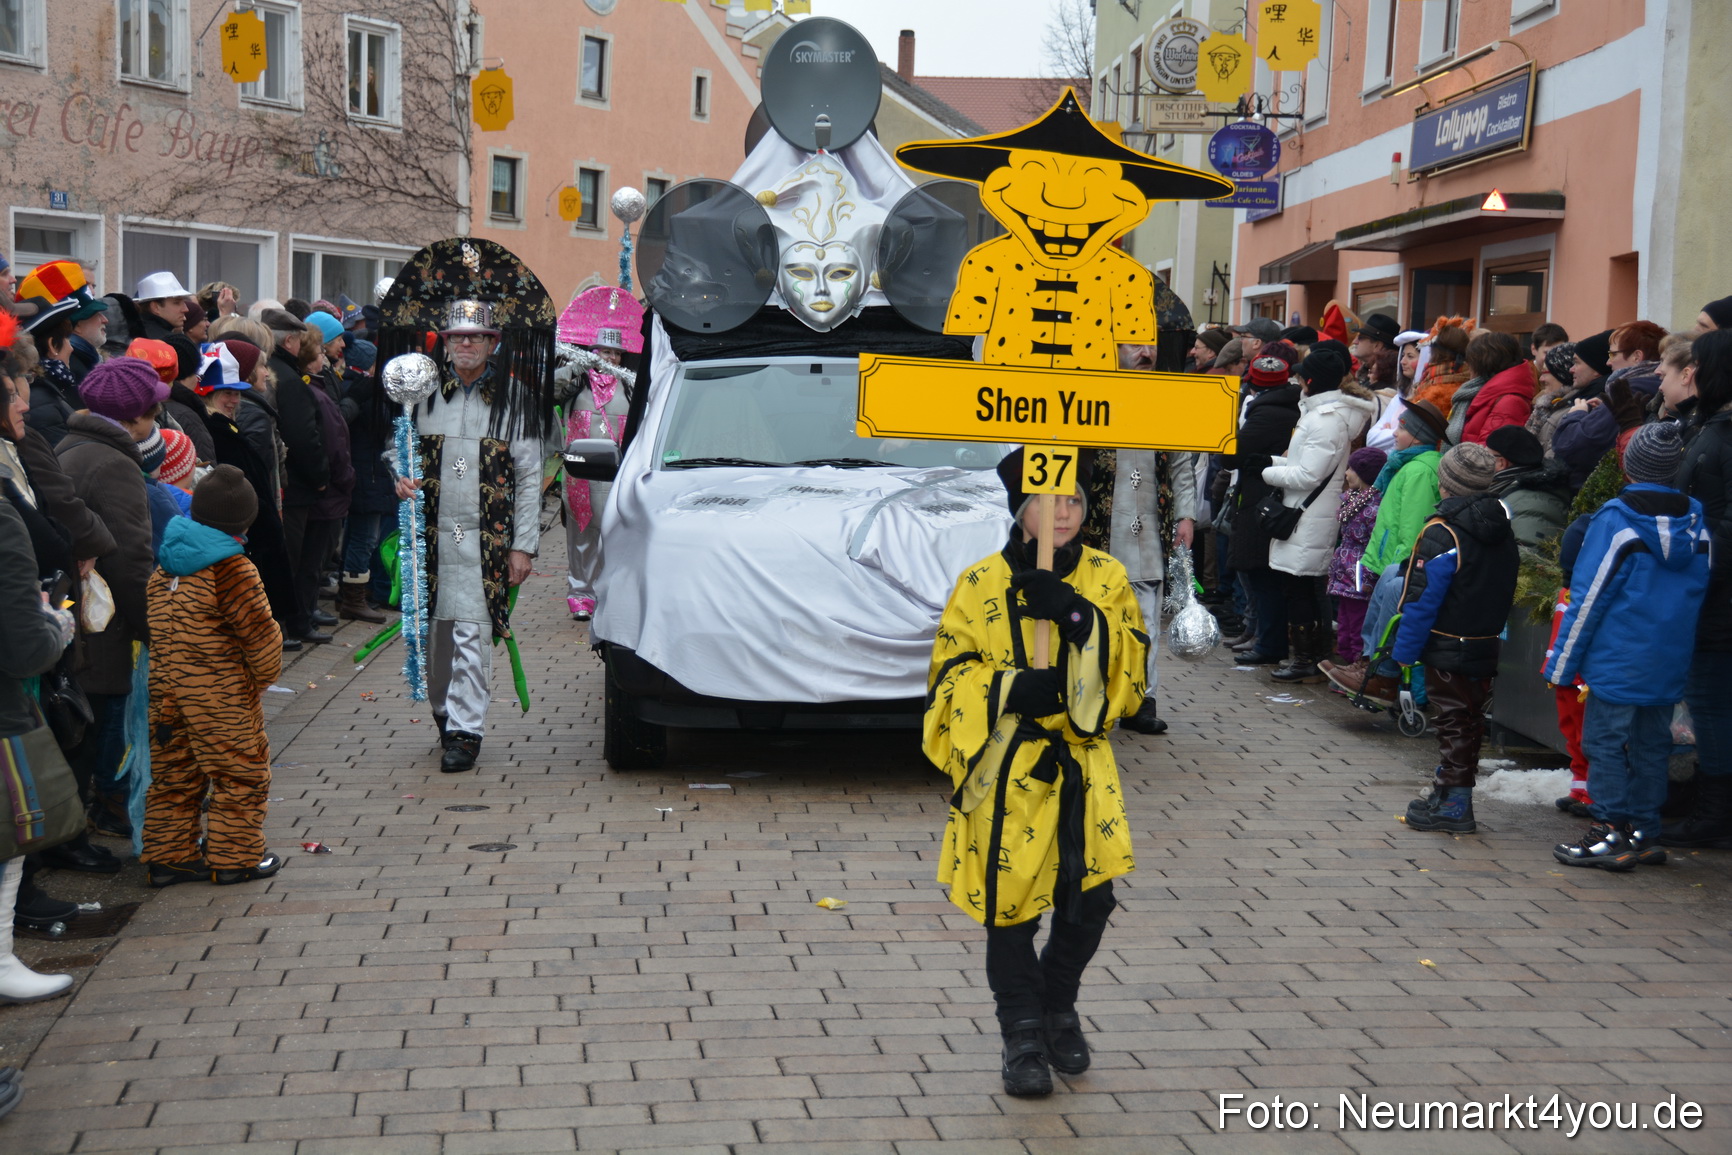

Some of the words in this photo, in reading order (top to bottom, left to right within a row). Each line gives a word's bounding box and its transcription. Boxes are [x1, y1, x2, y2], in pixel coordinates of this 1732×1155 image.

[1297, 27, 1314, 46] 华
[795, 51, 852, 63] SKYMASTER
[1155, 34, 1167, 50] EINE
[1170, 76, 1196, 85] UNTER
[1266, 45, 1281, 60] 人
[230, 61, 239, 75] 人
[1497, 93, 1517, 111] Bistro
[1164, 112, 1200, 120] STUDIO
[1486, 115, 1522, 137] Cocktailbar
[54, 192, 64, 202] 31
[976, 386, 1048, 424] Shen
[1058, 390, 1110, 427] Yun
[1028, 452, 1073, 488] 37
